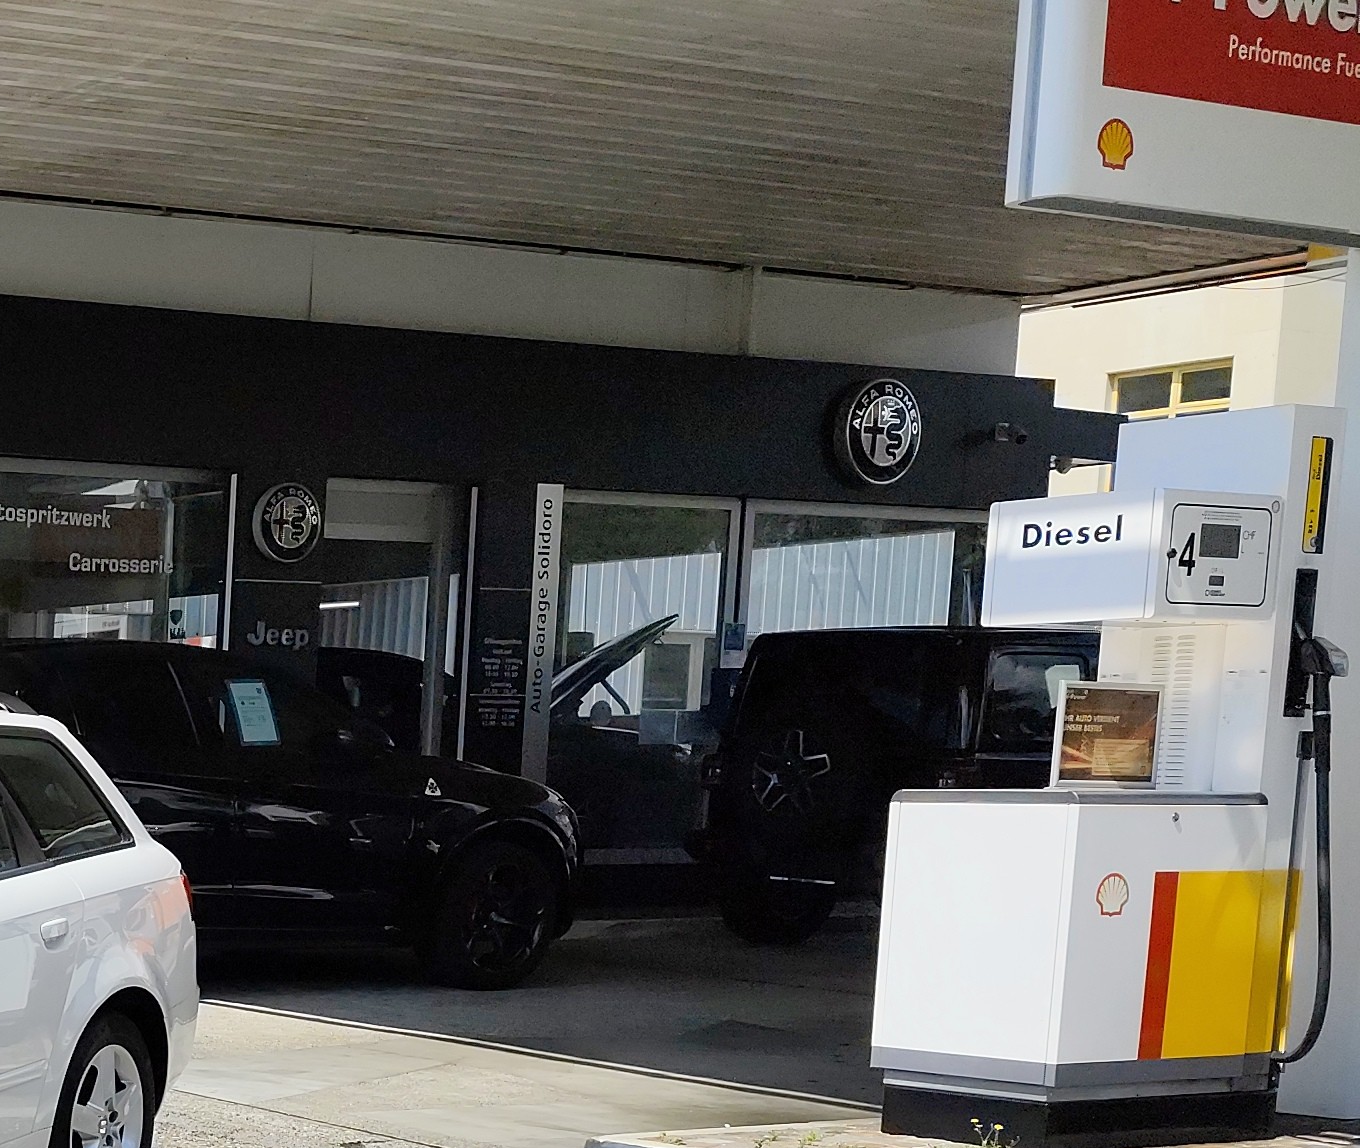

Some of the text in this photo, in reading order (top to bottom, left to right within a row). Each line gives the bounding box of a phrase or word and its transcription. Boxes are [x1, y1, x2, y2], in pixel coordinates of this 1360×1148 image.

[1228, 34, 1331, 73] Performance
[852, 384, 918, 435] ALFA ROMEO
[263, 487, 318, 525] ALFA ROMEO
[1020, 514, 1124, 550] Diesel
[68, 551, 175, 576] Carrosserie
[1178, 532, 1196, 577] 4
[529, 497, 555, 714] Auto-Garage Solidoro
[246, 619, 310, 652] Jeep
